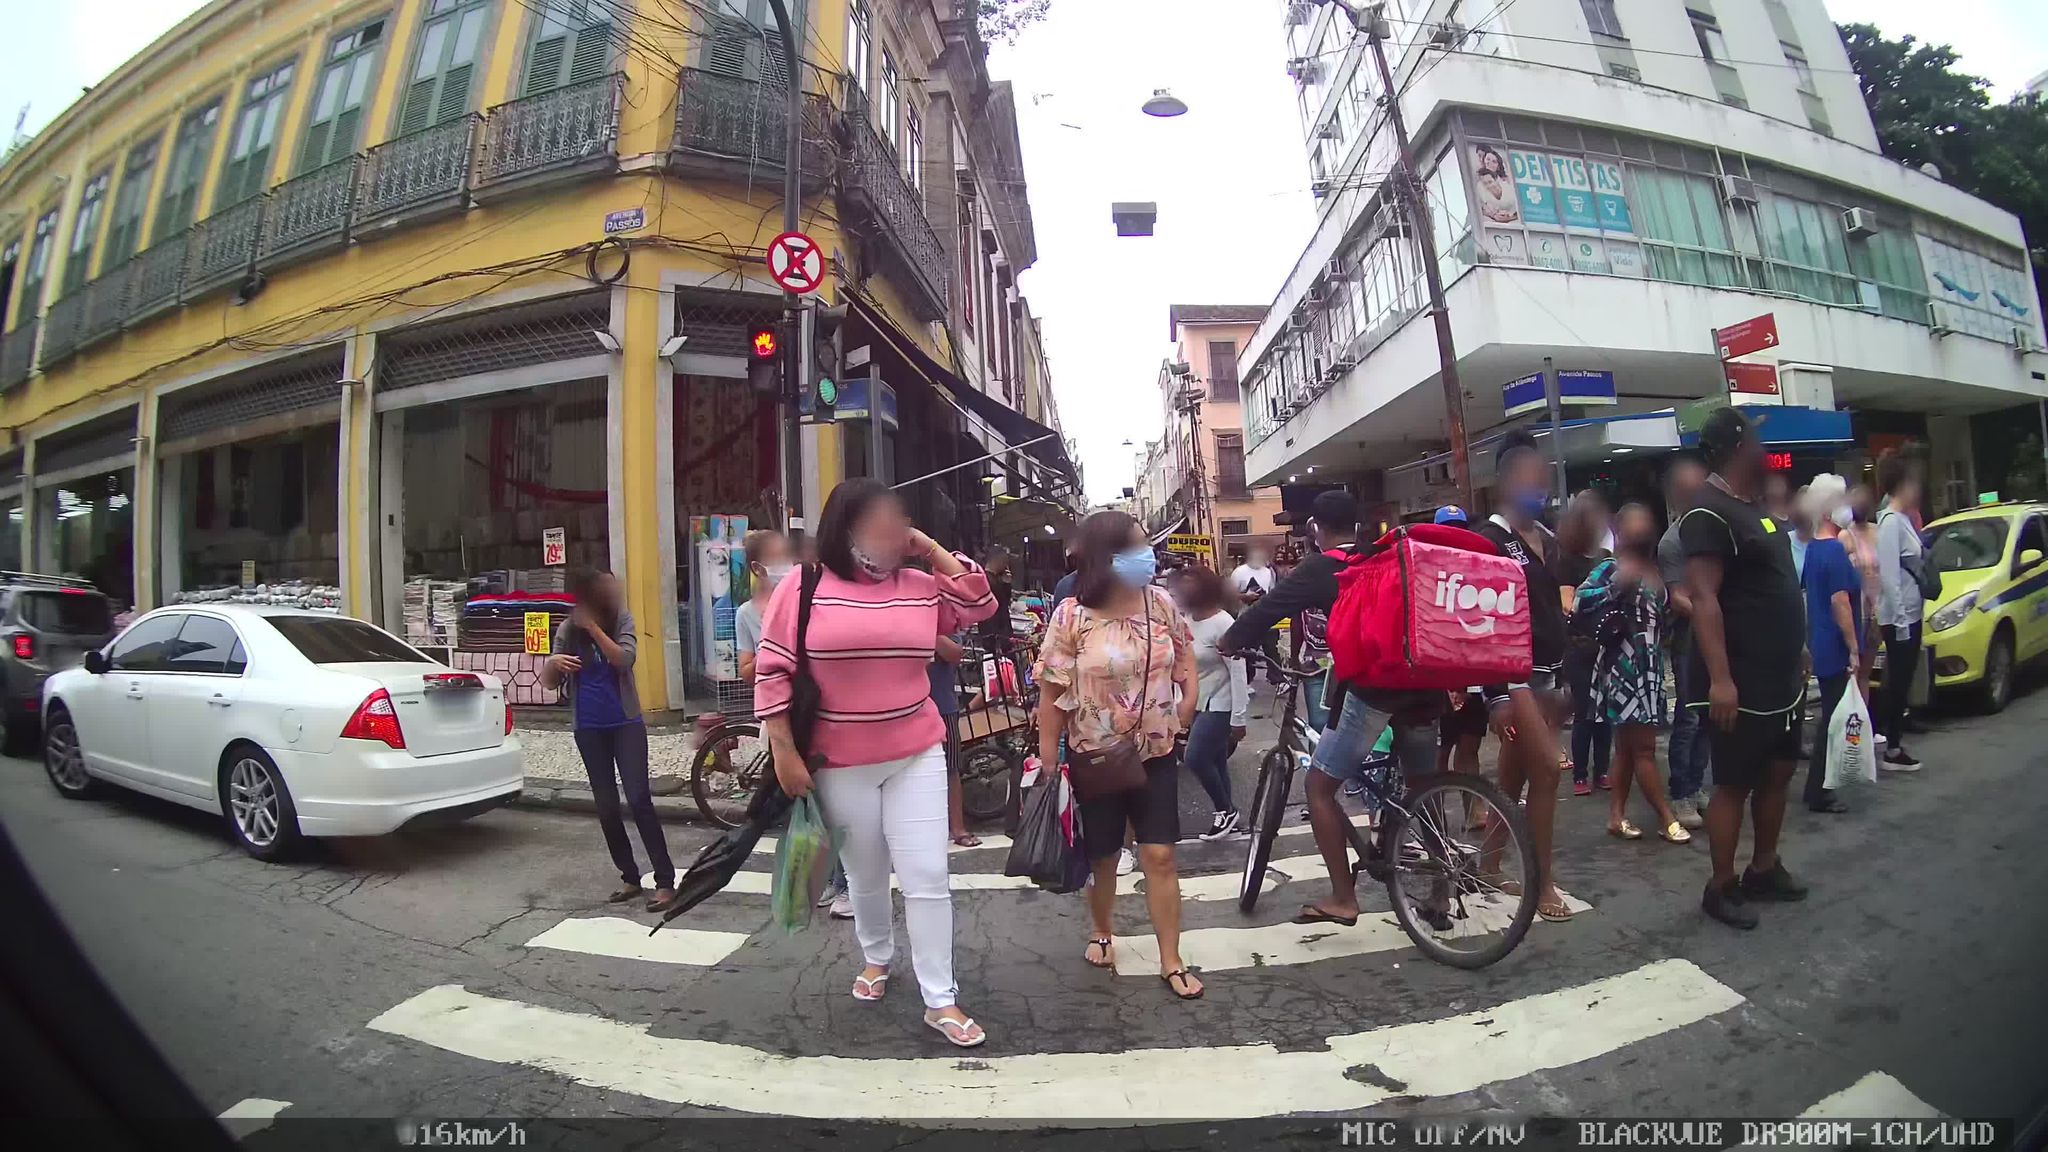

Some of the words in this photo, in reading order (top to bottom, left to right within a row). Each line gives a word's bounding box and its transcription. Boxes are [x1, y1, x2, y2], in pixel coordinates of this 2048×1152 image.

[1511, 153, 1622, 191] DENTISTAS
[606, 218, 641, 231] PASSOS
[1167, 537, 1210, 546] OURO
[1434, 570, 1516, 615] ifood
